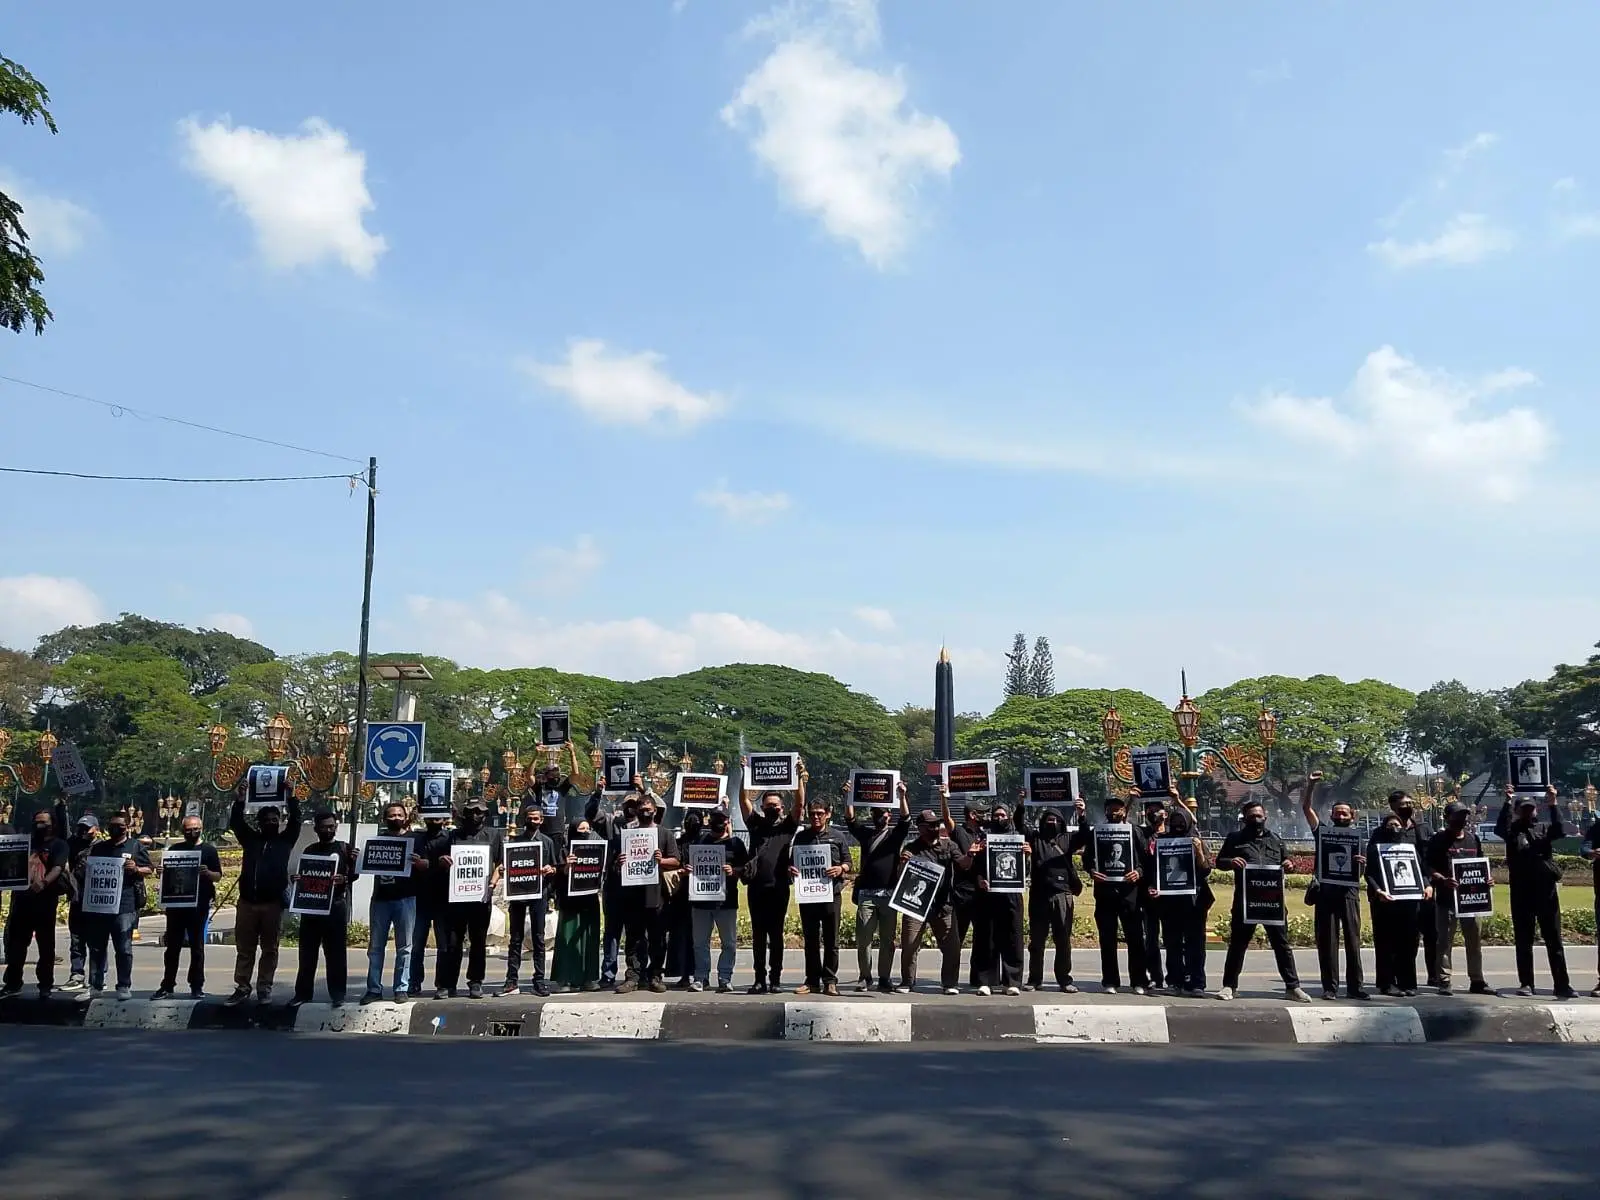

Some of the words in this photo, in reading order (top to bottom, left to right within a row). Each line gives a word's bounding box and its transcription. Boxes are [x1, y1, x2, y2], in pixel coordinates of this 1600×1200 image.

[756, 767, 788, 775] HARUS
[368, 851, 402, 860] HARUS
[630, 848, 650, 856] HAK
[458, 855, 483, 865] LONDO
[511, 859, 535, 868] PERS
[628, 860, 654, 868] LONDO
[801, 855, 826, 866] LONDO
[302, 869, 332, 878] LAWAN
[456, 867, 484, 879] IRENG
[628, 867, 654, 876] IRENG
[695, 865, 721, 876] IRENG
[1462, 869, 1481, 877] ANTI
[90, 877, 118, 889] IRENG
[509, 875, 538, 883] RAKYAT
[1459, 877, 1486, 885] KRITIK
[458, 884, 483, 892] PERS
[696, 882, 721, 892] LONDO
[803, 885, 828, 893] PERS
[90, 895, 115, 905] LONDO
[1460, 893, 1487, 901] TAKUT
